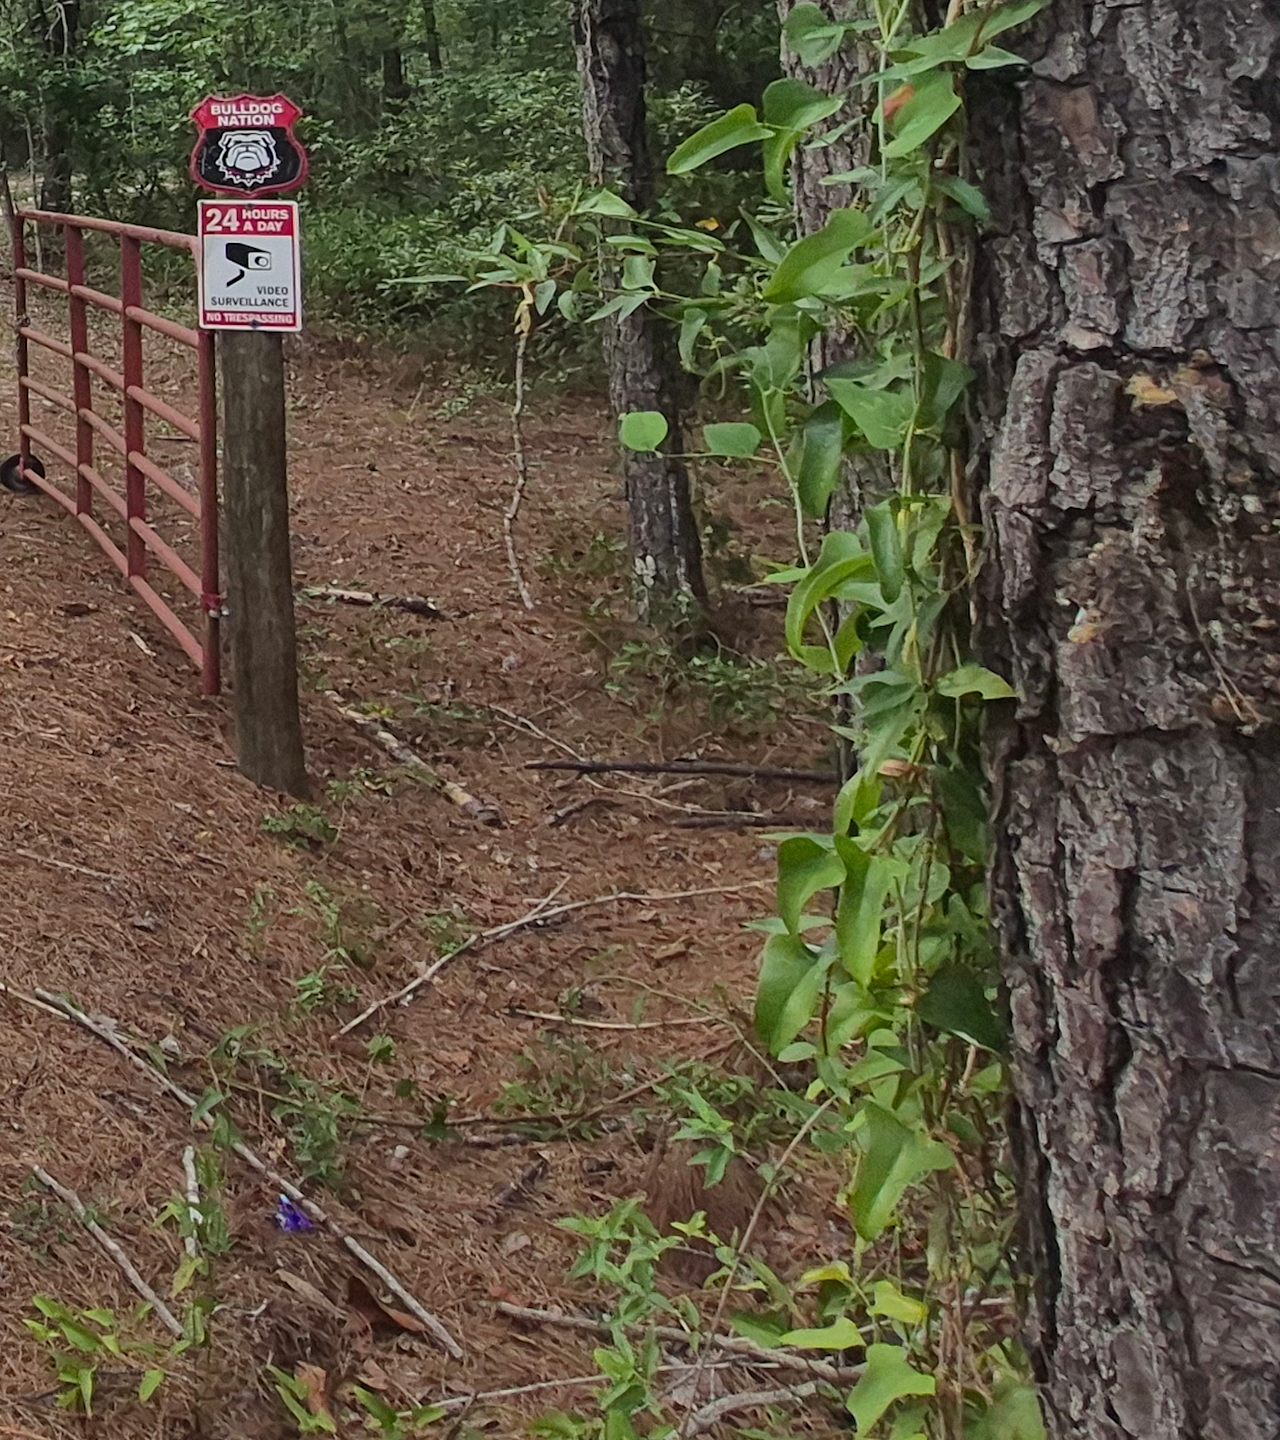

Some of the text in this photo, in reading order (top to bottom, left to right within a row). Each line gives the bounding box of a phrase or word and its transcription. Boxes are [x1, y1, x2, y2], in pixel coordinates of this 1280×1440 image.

[210, 102, 283, 116] BULLDOG
[217, 115, 275, 127] NATION
[205, 208, 289, 232] 24 HOURS
[243, 221, 283, 232] A DAY
[256, 285, 289, 296] VIDEO
[210, 296, 289, 308] SURVEILLANCE
[206, 312, 293, 325] NO TRESPASSING
